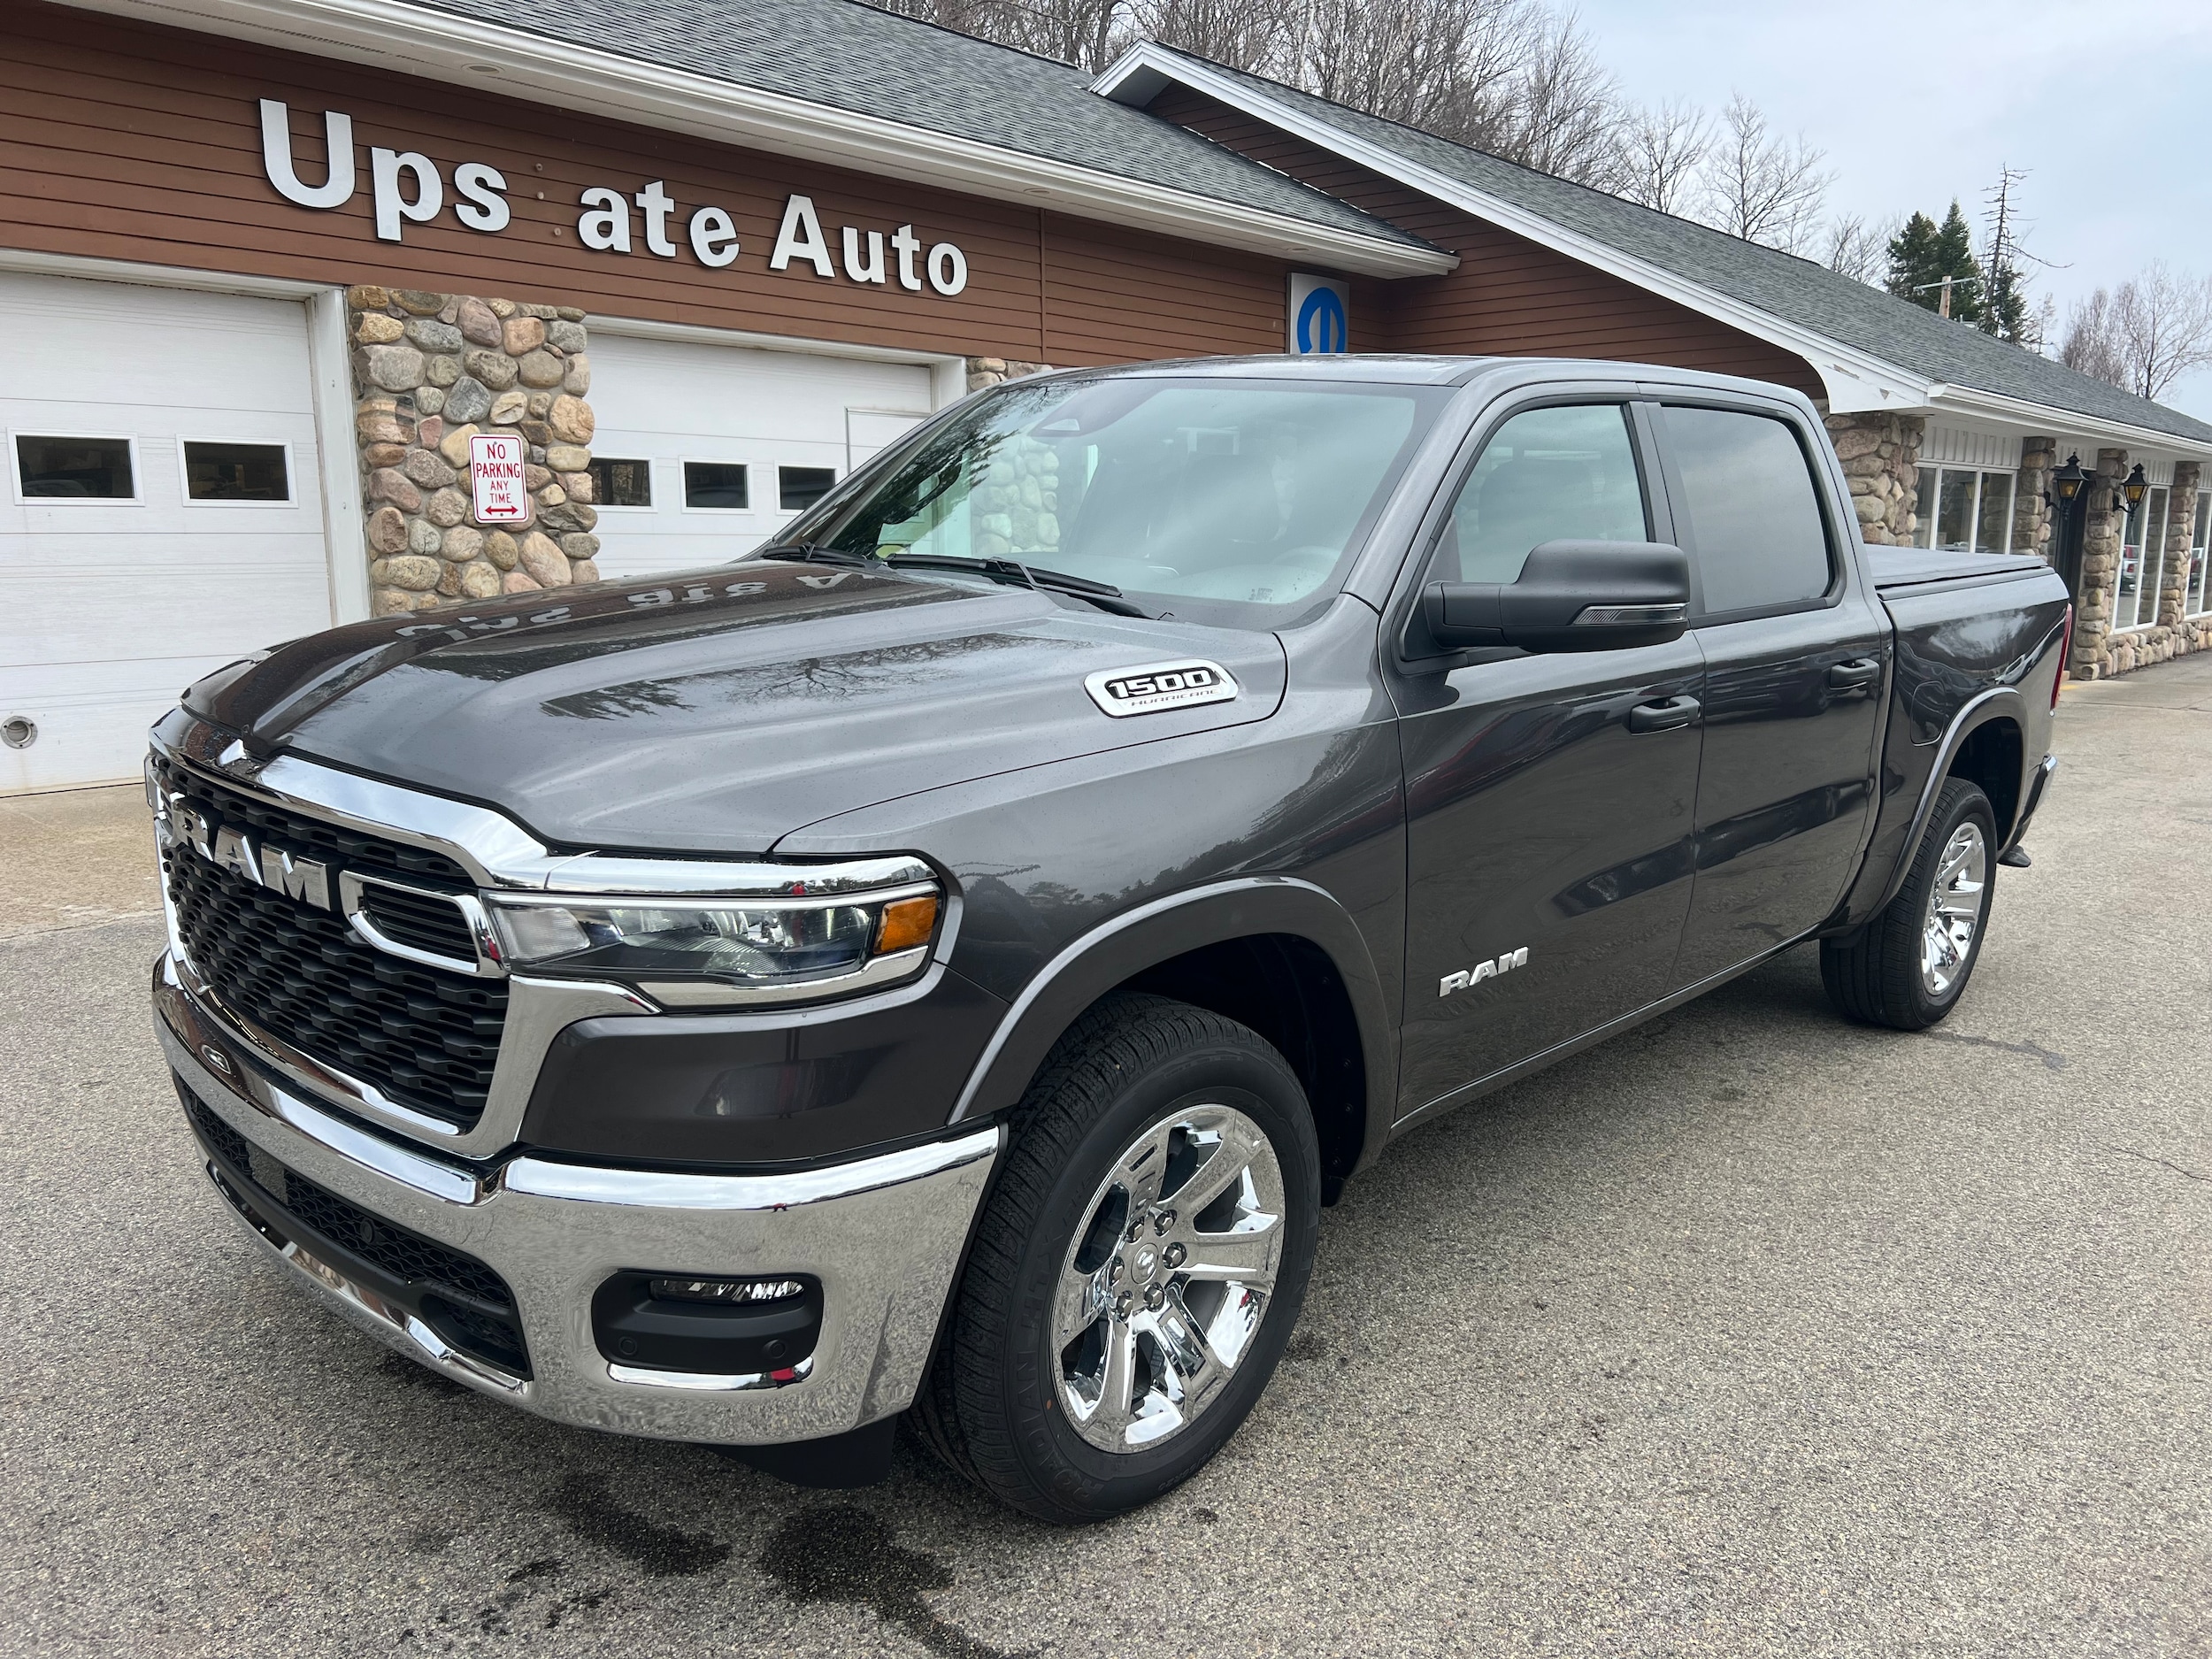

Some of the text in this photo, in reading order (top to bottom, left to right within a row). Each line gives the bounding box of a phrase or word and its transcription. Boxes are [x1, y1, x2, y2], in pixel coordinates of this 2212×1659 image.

[768, 193, 969, 297] Auto
[488, 444, 506, 458] NO
[476, 463, 520, 478] PARKING
[490, 480, 509, 491] ANY
[489, 493, 512, 503] TIME
[1110, 670, 1212, 698] 1500
[173, 800, 333, 912] RAM
[1439, 946, 1529, 998] RAM
